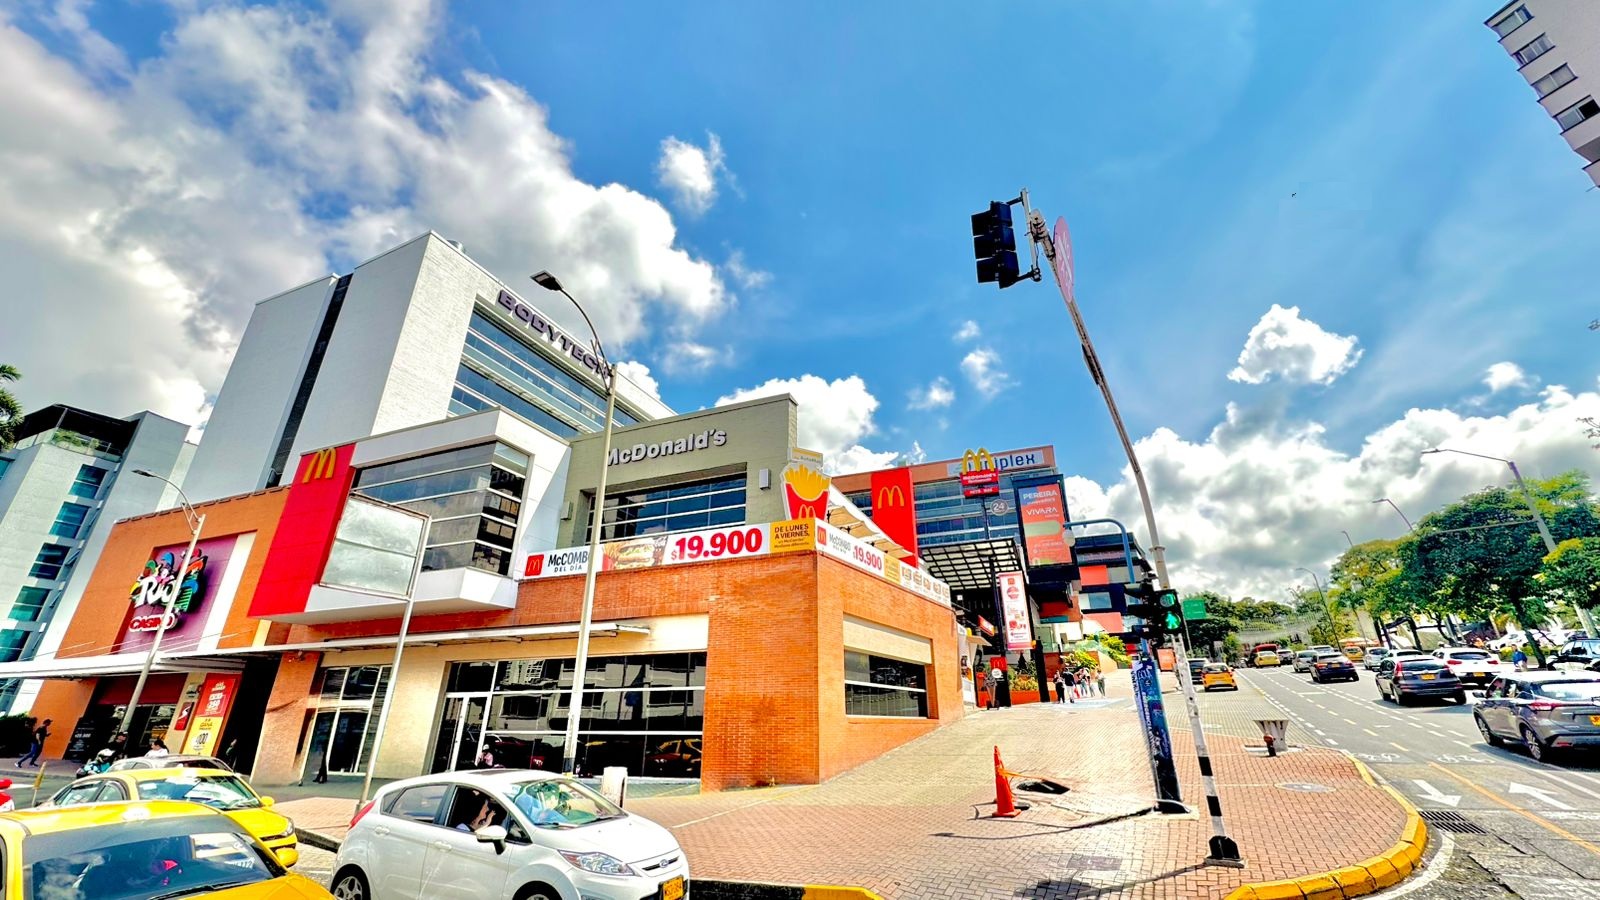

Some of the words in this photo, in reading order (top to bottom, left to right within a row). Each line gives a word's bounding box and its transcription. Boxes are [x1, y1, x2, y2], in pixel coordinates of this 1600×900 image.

[498, 289, 611, 380] BODYTECH
[607, 429, 728, 467] McDonald's
[1023, 489, 1058, 500] PEREIRA
[1026, 506, 1058, 516] VIVARA
[786, 524, 809, 532] LUNES
[671, 528, 763, 561] $19.900
[548, 551, 589, 567] McCOMB
